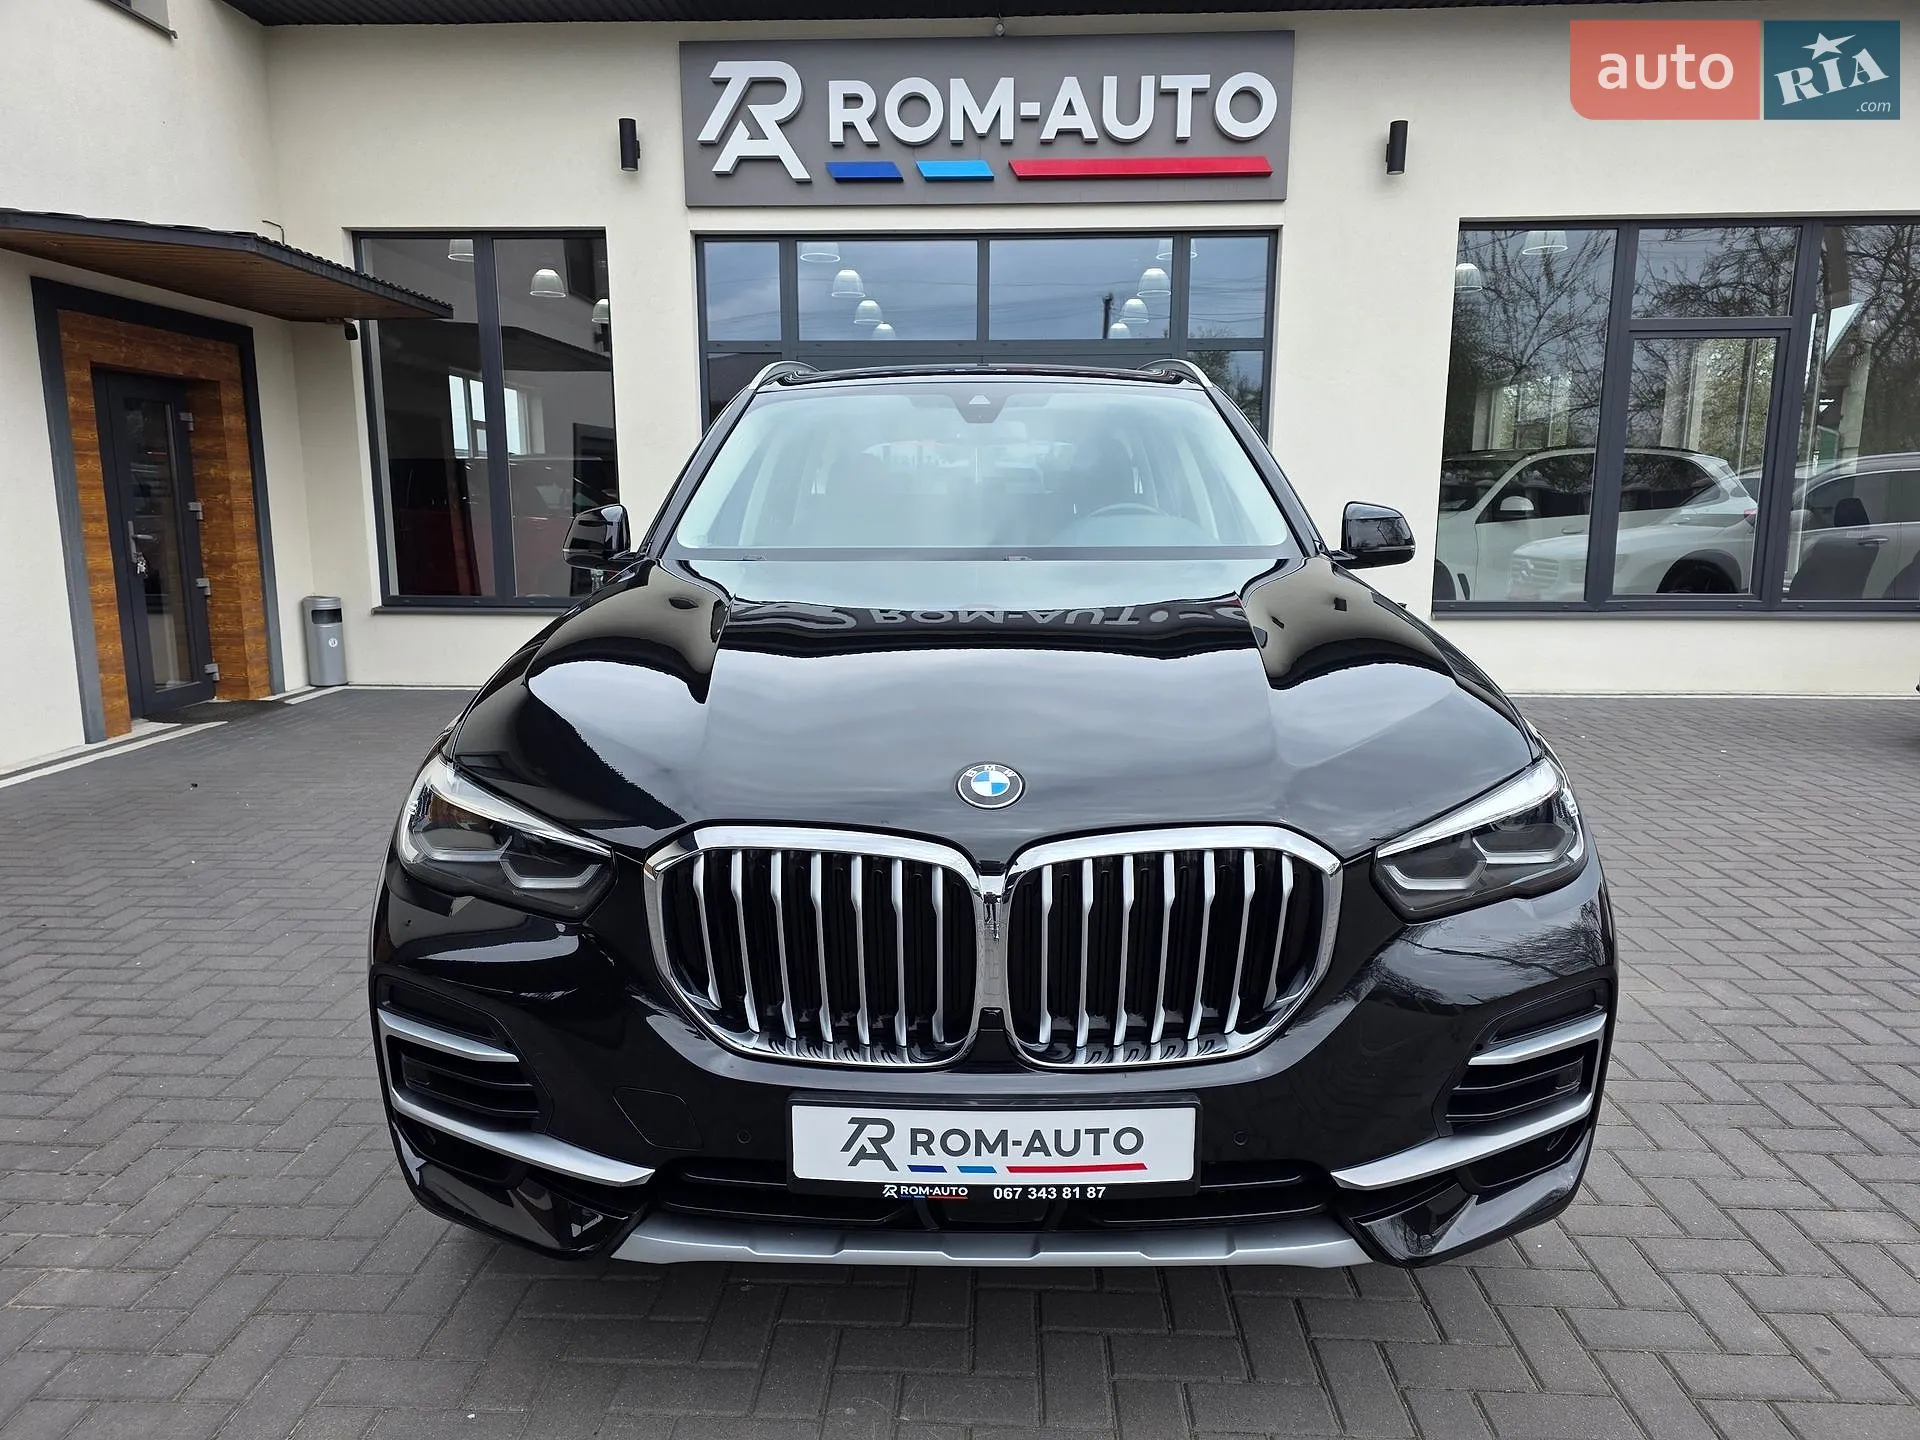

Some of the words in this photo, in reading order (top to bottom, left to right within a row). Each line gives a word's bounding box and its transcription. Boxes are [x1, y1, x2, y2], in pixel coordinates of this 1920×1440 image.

[827, 71, 1278, 146] ROM-AUTO
[964, 764, 1017, 778] BMW
[909, 1126, 1145, 1158] ROM-AUTO
[900, 1185, 969, 1196] ROM-AUTO
[993, 1186, 1023, 1200] 067
[1027, 1187, 1057, 1199] 343
[1061, 1187, 1081, 1199] 81
[1086, 1186, 1107, 1199] 87
